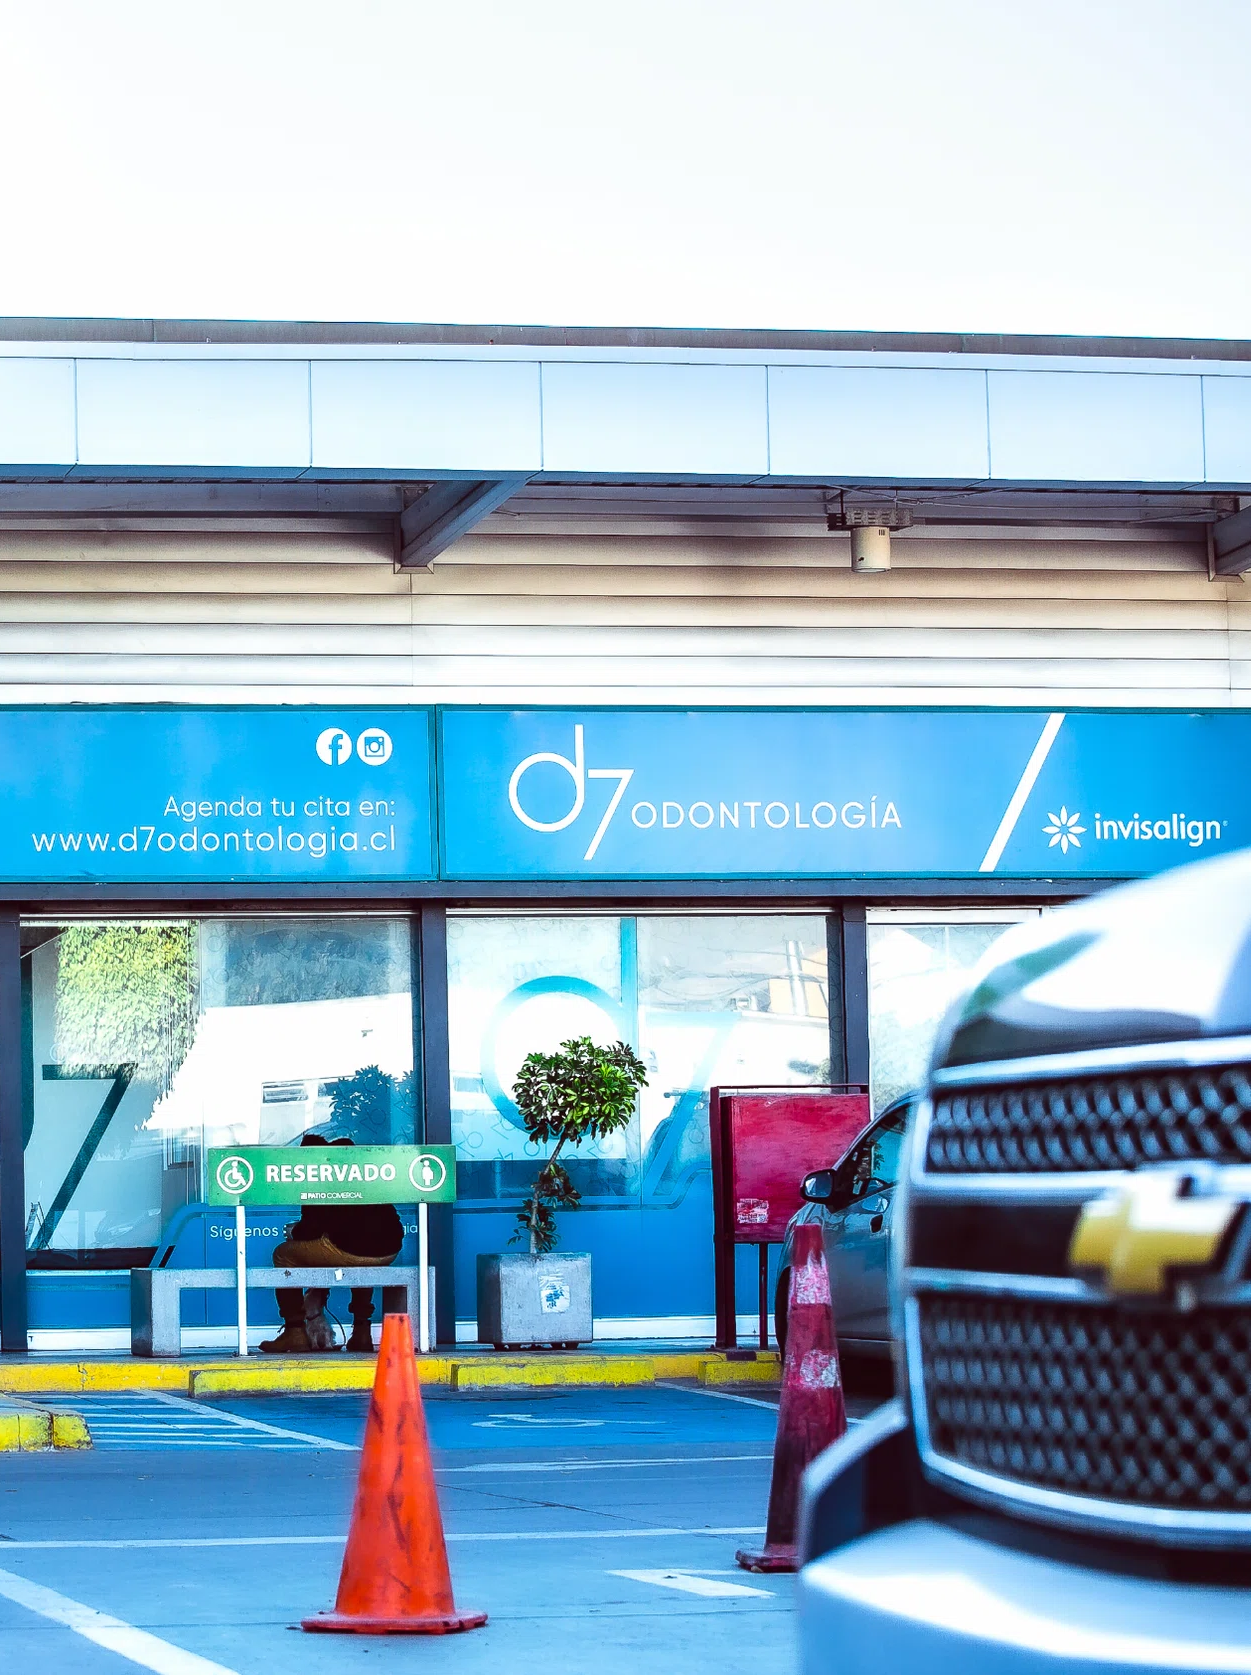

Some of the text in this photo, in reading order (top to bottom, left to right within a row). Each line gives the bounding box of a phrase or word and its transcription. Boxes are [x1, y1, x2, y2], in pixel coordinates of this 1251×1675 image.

[508, 724, 902, 861] d7 ODONTOLOGÍA
[164, 795, 396, 822] Agenda tu cita en:
[32, 826, 396, 857] www.d7odontologia.cl
[266, 1163, 397, 1183] RESERVADO
[326, 1191, 363, 1199] COMERCIAL
